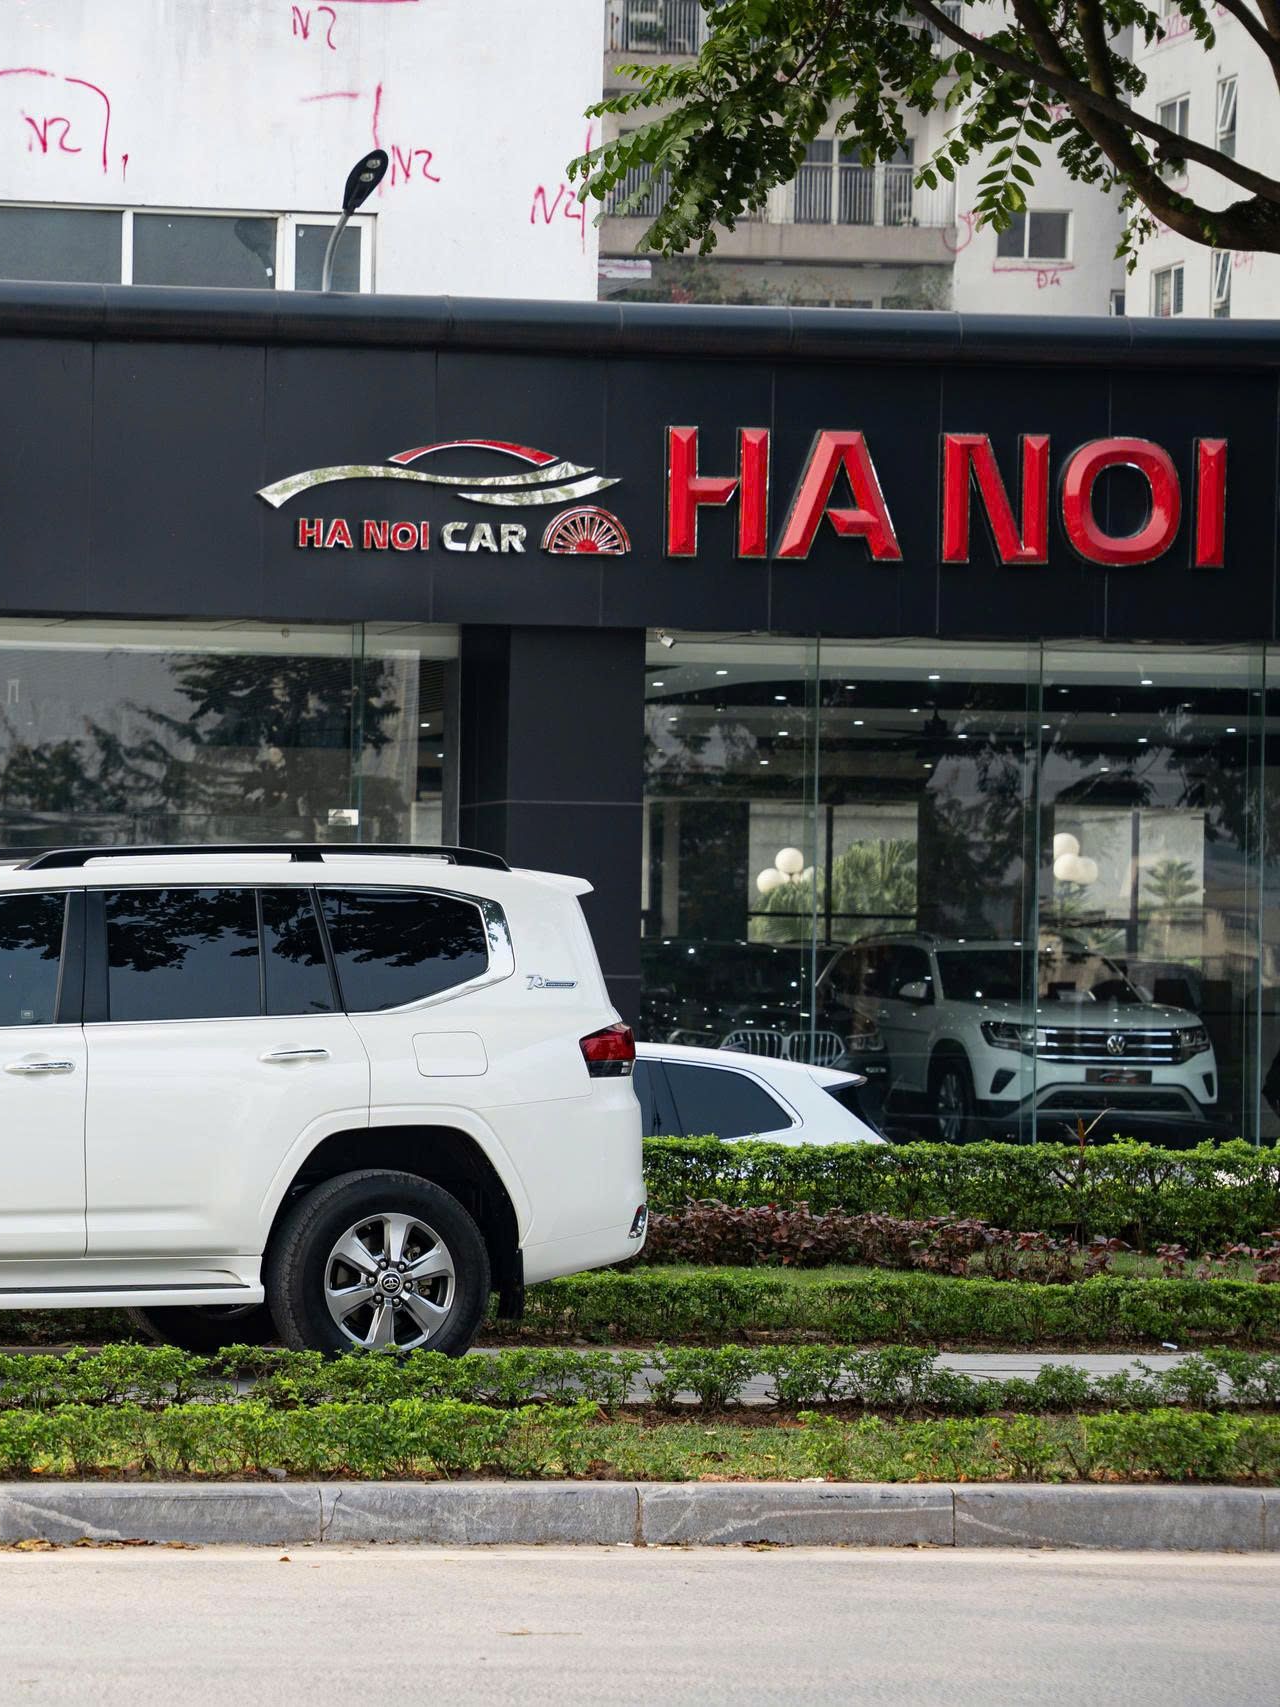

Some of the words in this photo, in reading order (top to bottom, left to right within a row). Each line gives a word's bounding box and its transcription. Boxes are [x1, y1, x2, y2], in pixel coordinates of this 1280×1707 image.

[23, 115, 82, 154] N2
[390, 144, 441, 187] N2
[664, 425, 903, 561] HA
[938, 432, 1228, 568] NOI
[298, 517, 353, 549] HA
[363, 519, 430, 550] NOI
[440, 521, 527, 553] CAR
